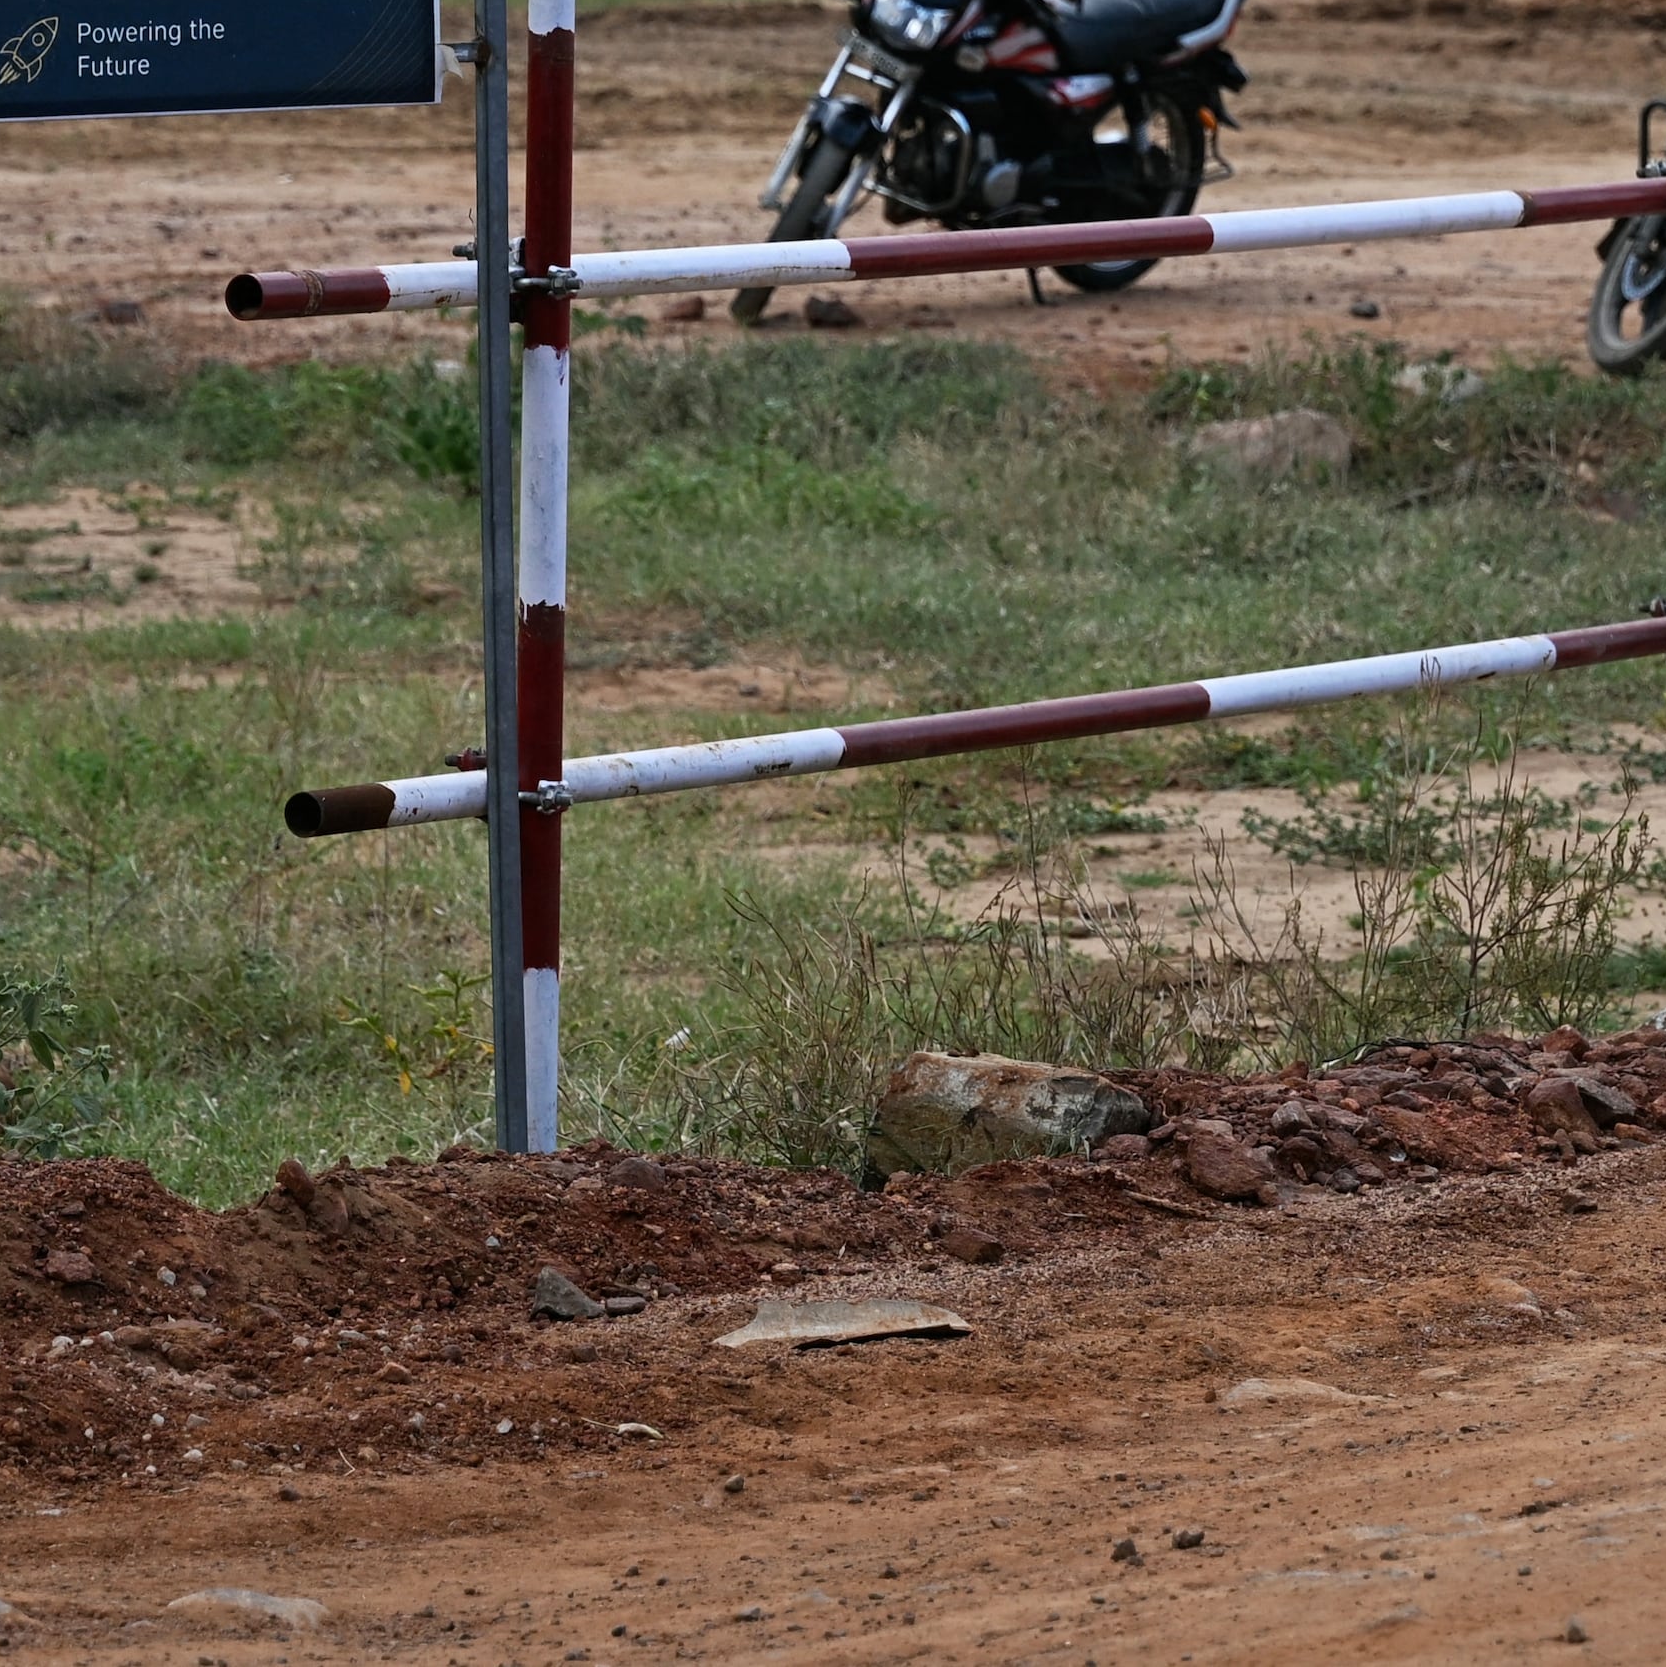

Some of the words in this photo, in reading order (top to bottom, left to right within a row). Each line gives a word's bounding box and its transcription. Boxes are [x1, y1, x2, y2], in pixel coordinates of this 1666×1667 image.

[78, 21, 180, 45] Powering
[191, 18, 224, 40] the
[79, 56, 149, 76] Future
